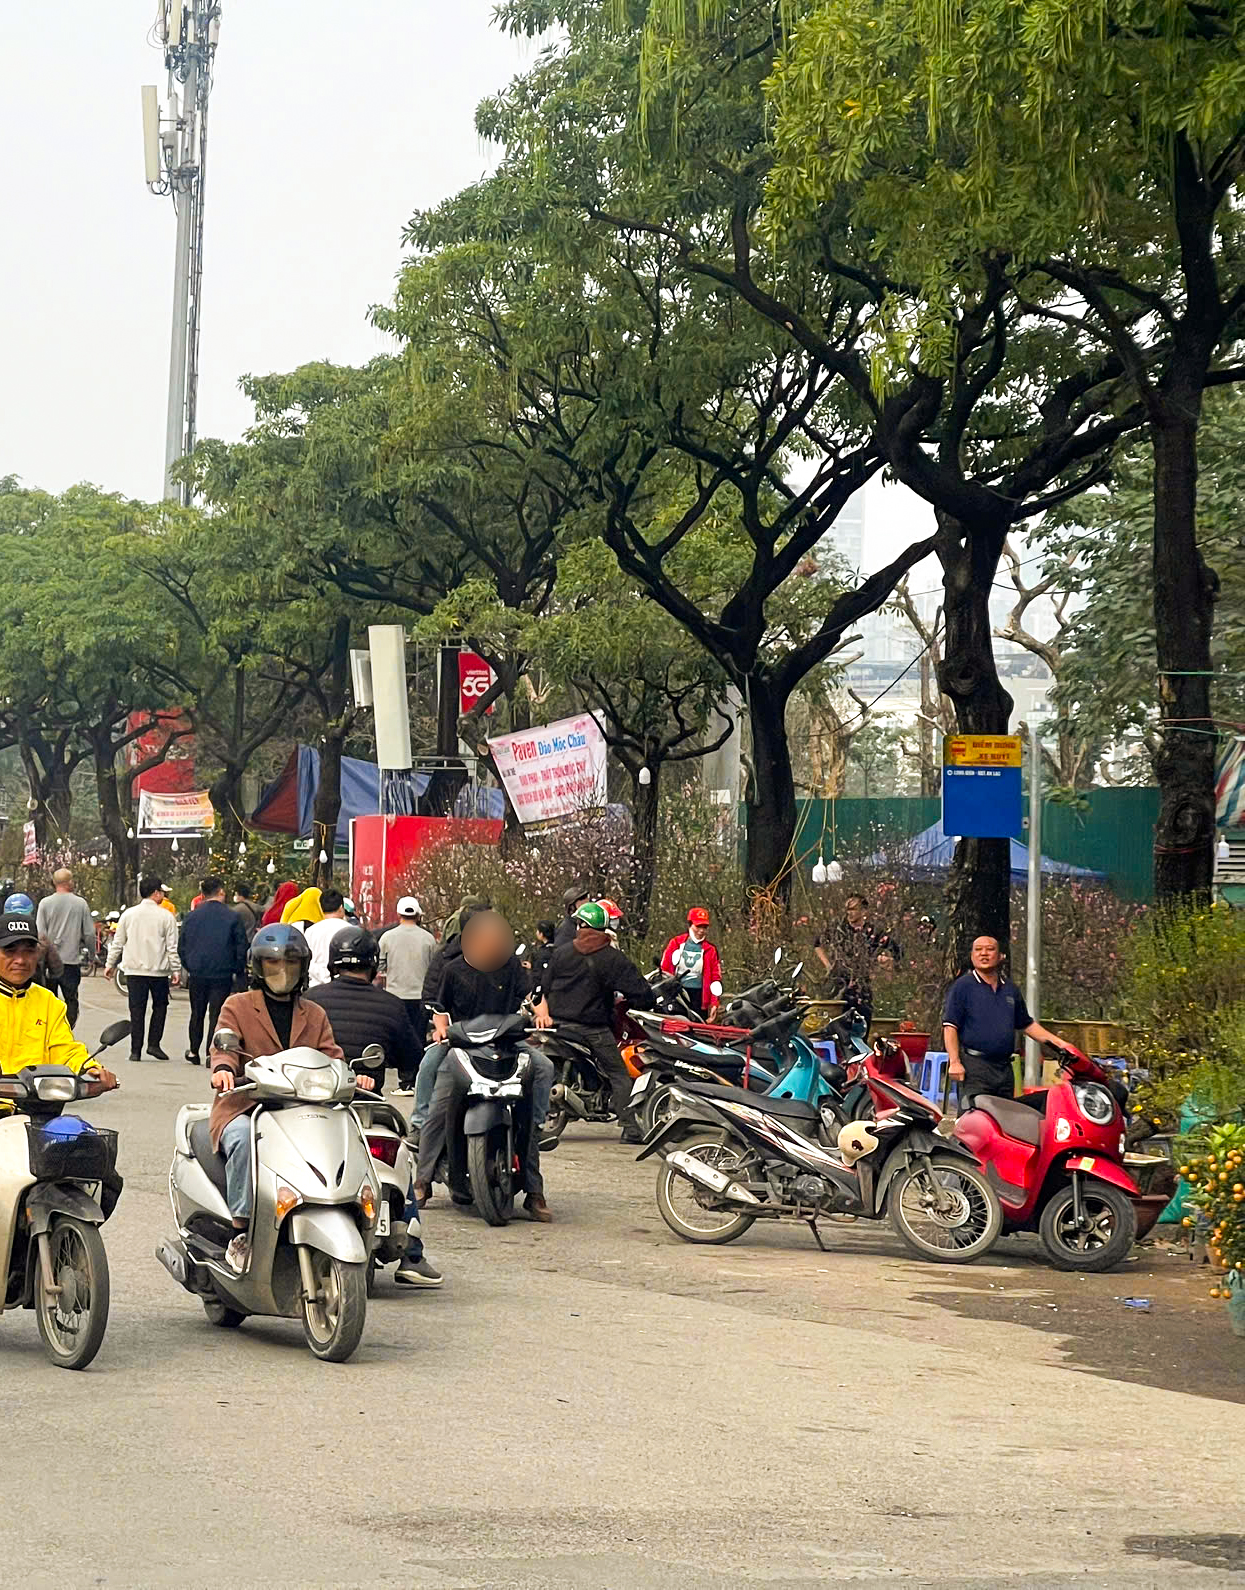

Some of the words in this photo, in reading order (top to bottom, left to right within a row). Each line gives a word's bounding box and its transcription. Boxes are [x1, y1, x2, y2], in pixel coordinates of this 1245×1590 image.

[461, 676, 490, 697] 5G
[511, 740, 537, 762] Paven
[567, 731, 586, 748] Châu
[7, 921, 30, 932] GUCCI
